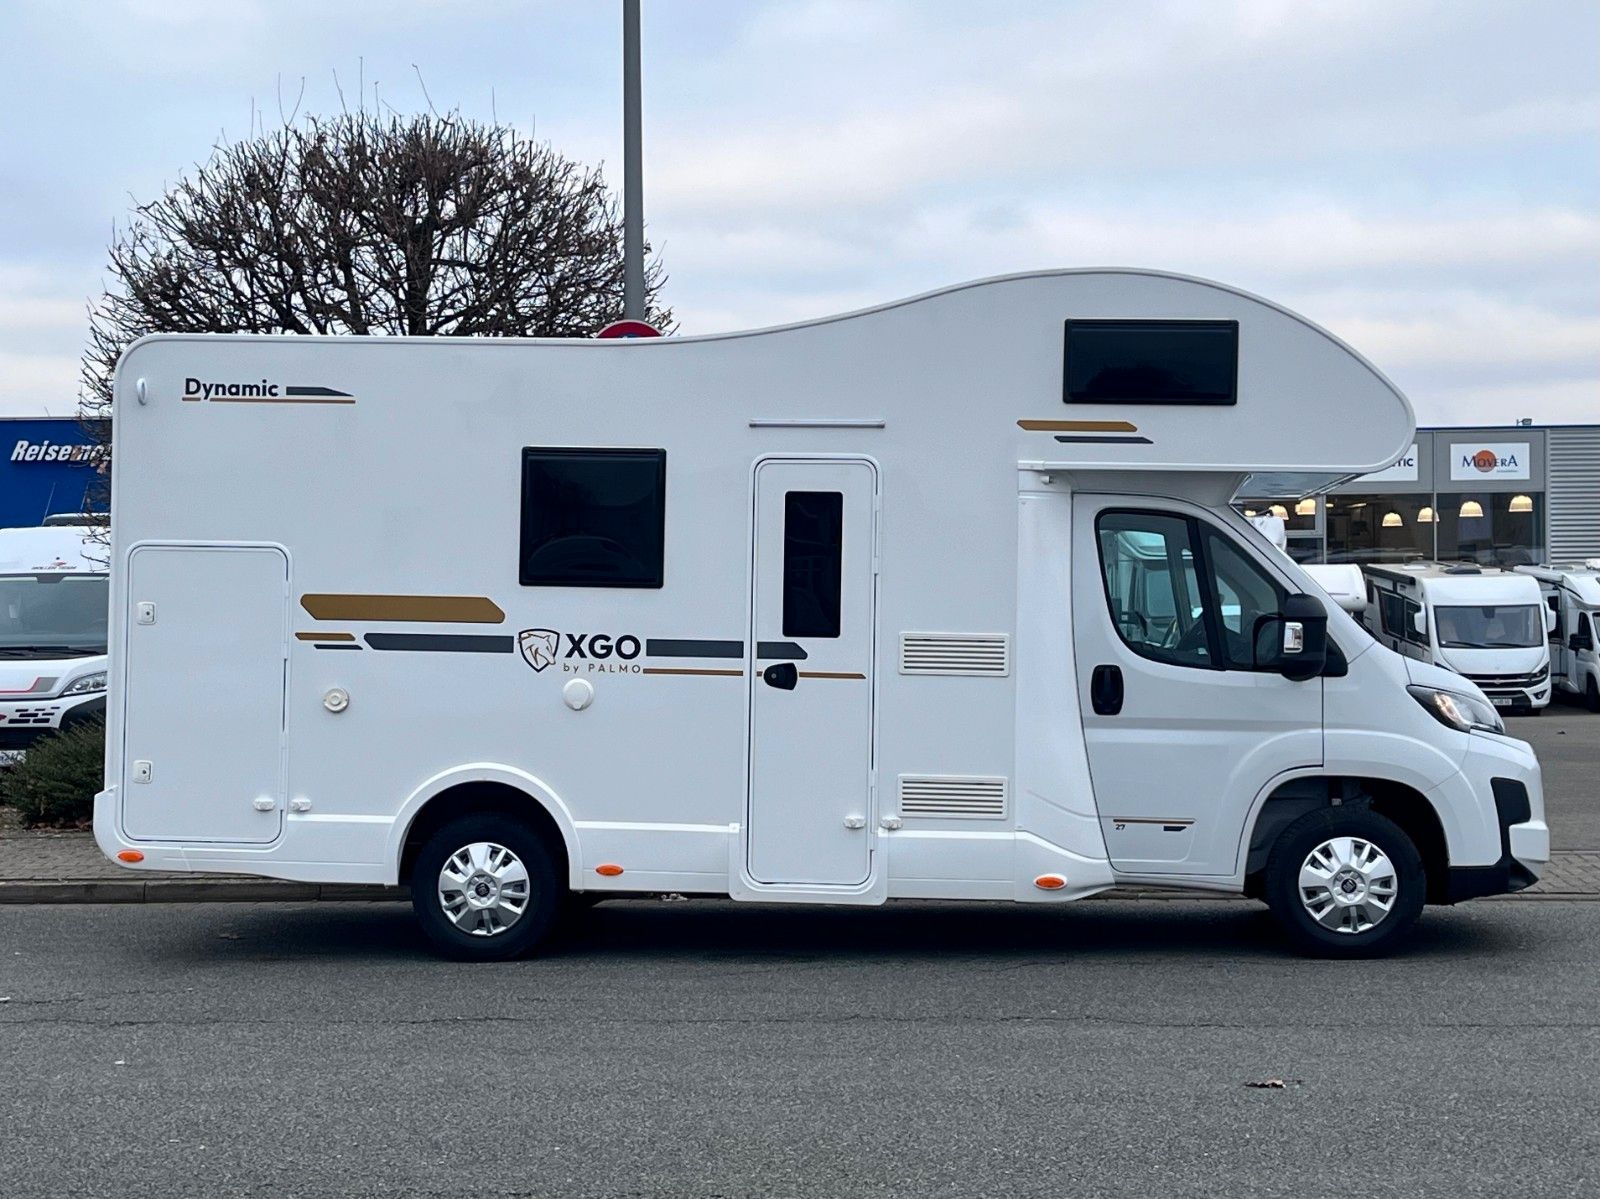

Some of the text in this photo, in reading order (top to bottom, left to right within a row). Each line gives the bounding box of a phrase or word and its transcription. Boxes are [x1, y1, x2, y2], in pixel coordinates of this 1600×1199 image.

[184, 377, 279, 400] Dynamic
[564, 633, 641, 660] XGO
[563, 663, 641, 674] by PALMO
